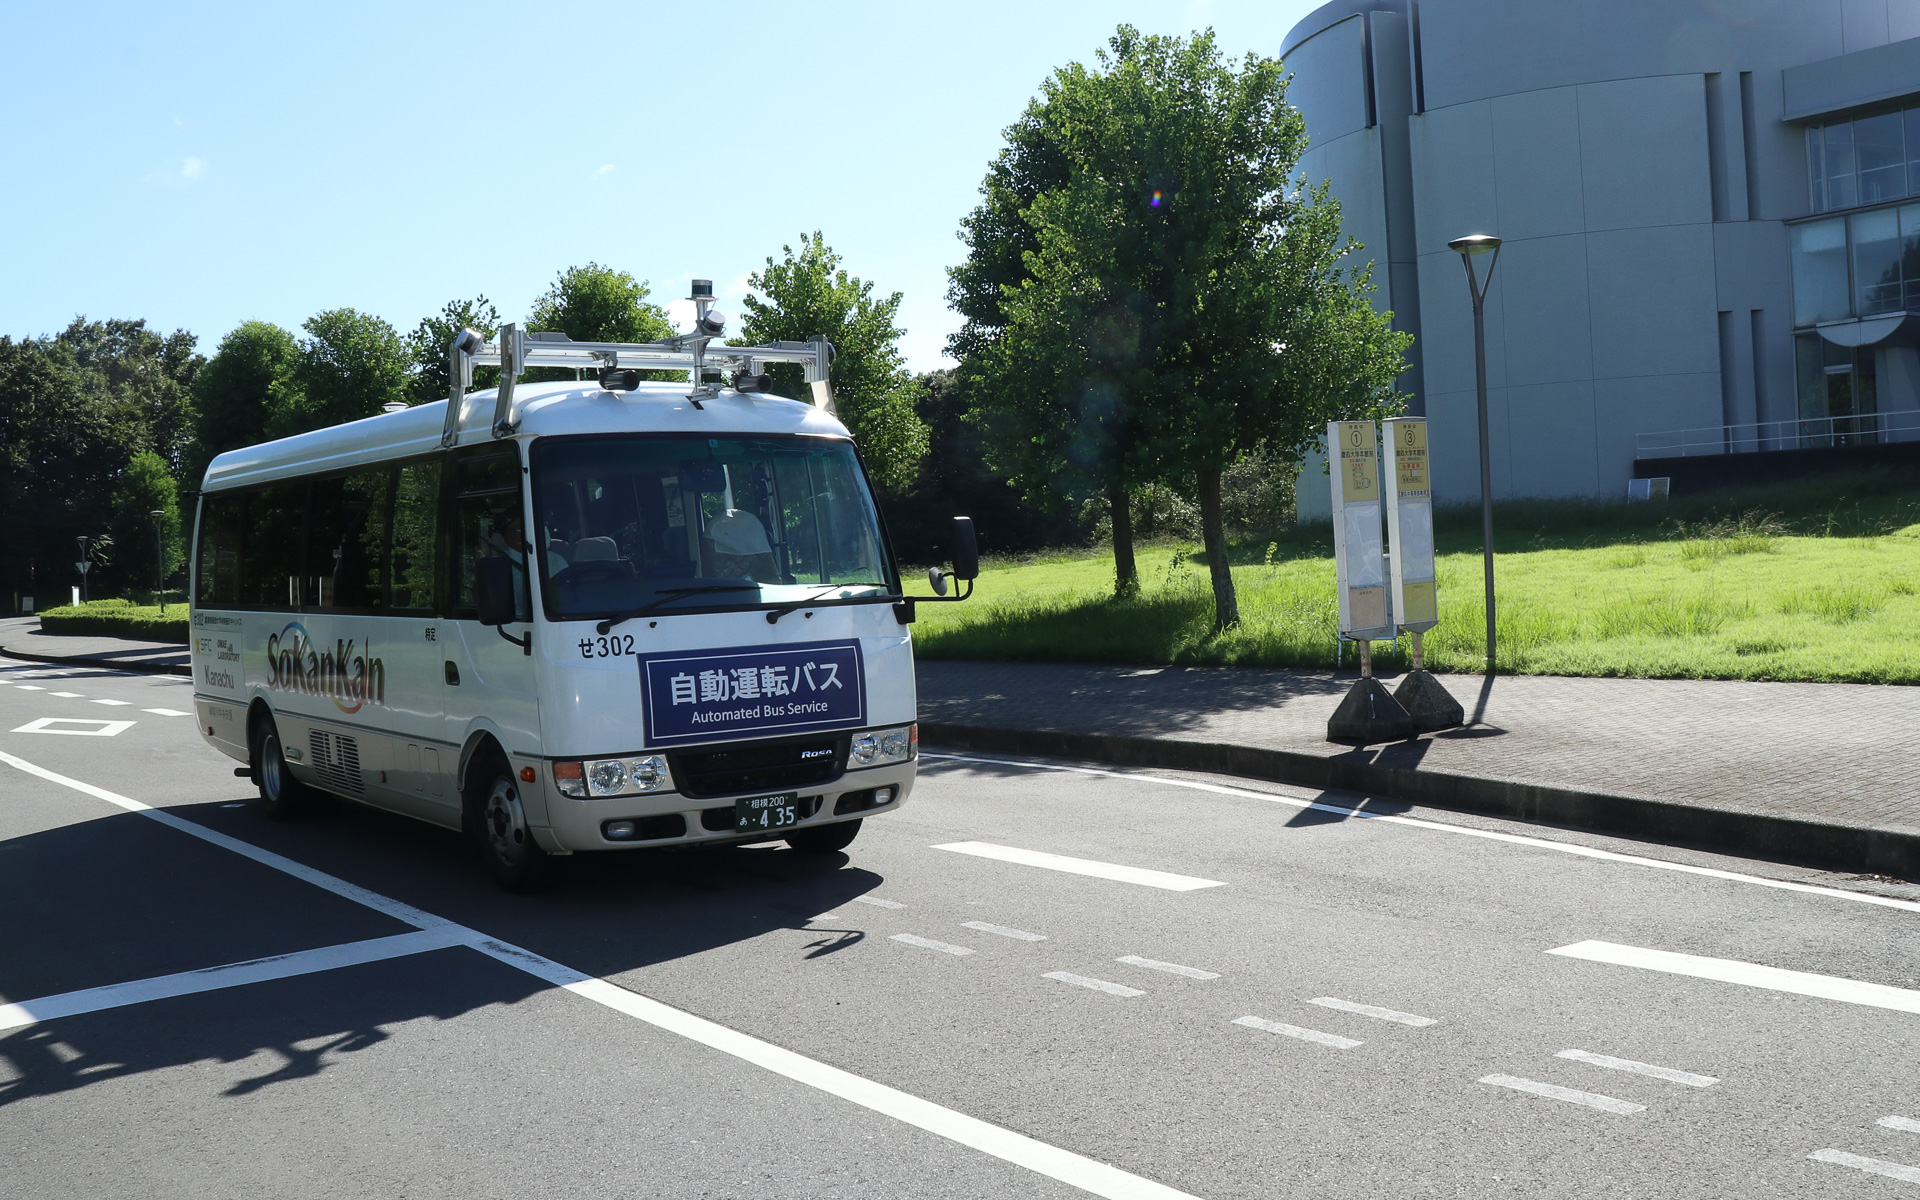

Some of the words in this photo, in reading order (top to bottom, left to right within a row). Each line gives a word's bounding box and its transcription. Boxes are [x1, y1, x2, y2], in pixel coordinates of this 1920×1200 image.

[204, 664, 235, 689] Kanachu
[670, 661, 843, 706] 自動運転バス
[691, 705, 761, 724] Automated
[763, 703, 785, 717] Bus
[787, 700, 828, 715] Service
[739, 816, 748, 826] あ
